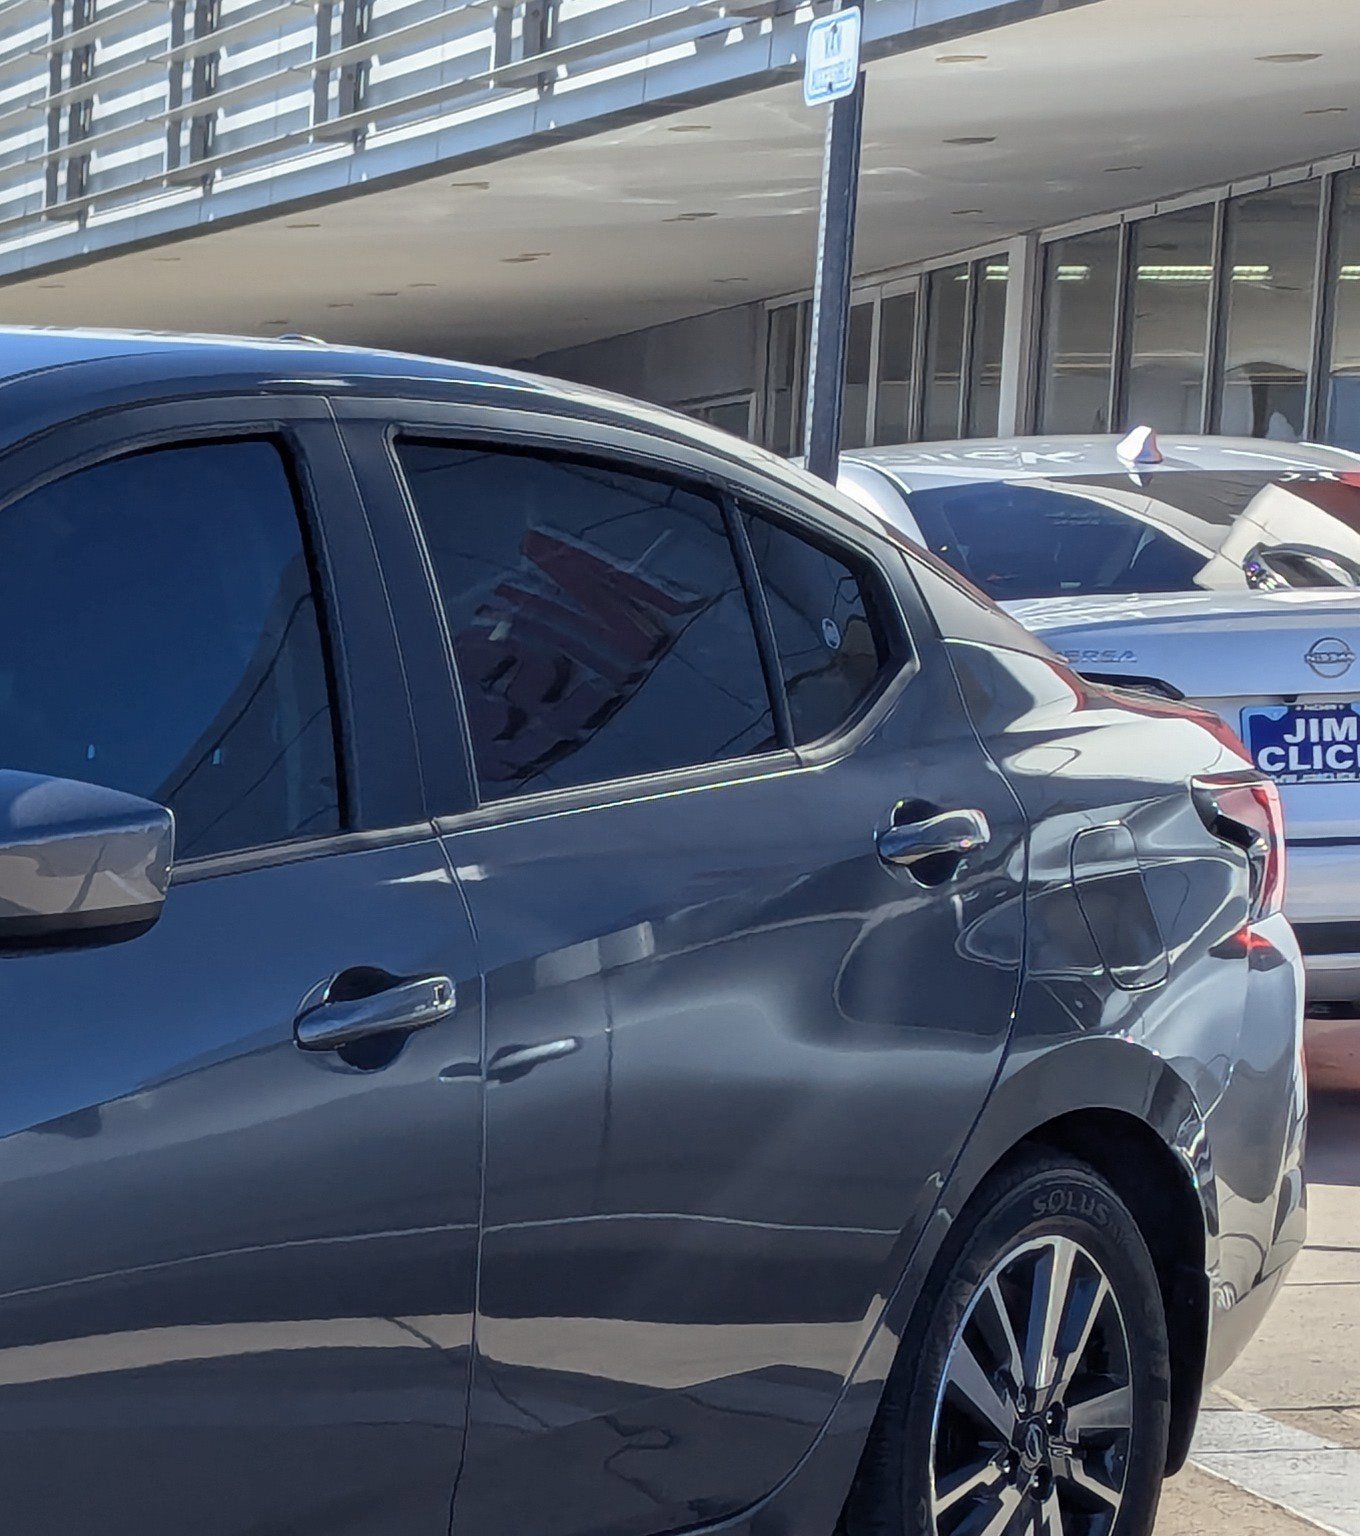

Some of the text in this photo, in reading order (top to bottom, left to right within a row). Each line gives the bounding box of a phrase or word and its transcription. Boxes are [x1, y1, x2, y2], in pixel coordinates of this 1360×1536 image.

[1283, 716, 1358, 744] JIM
[1257, 744, 1360, 772] CLIC
[1032, 1187, 1111, 1227] SOLUS
